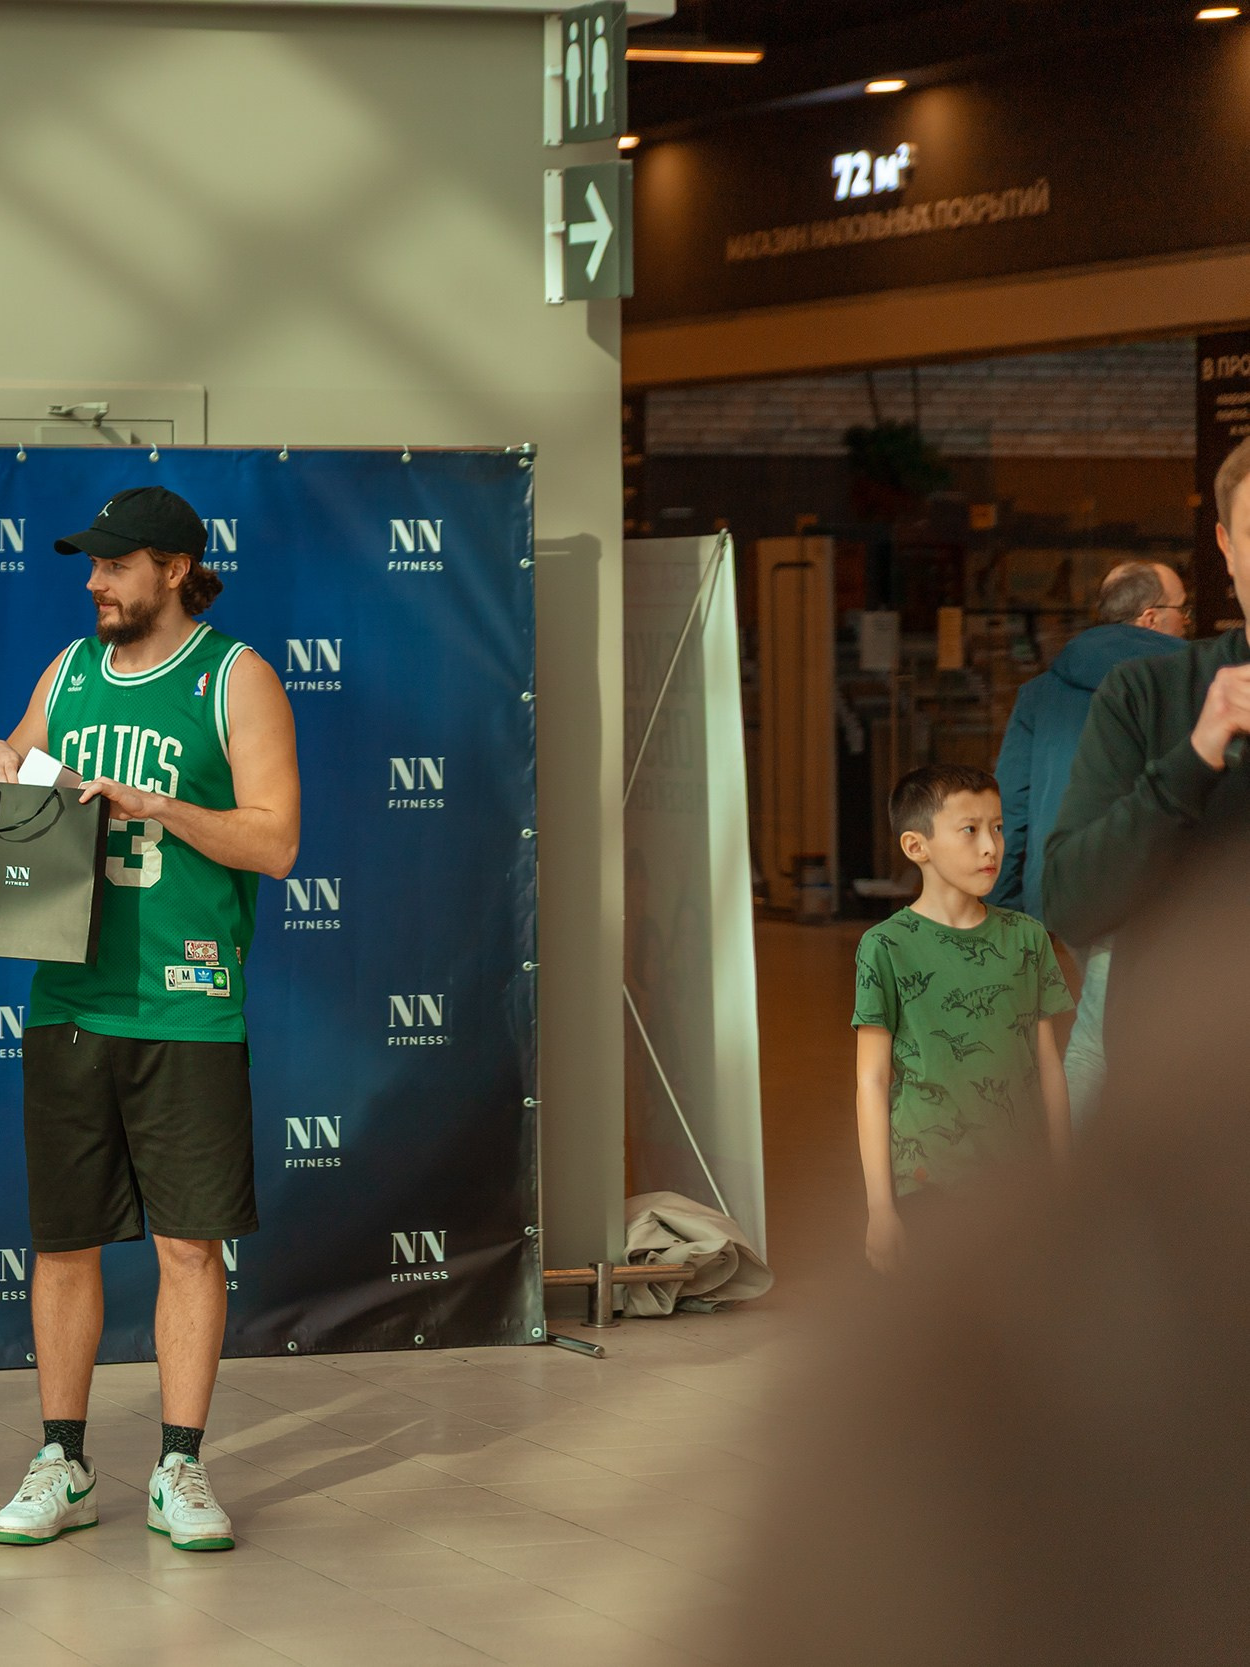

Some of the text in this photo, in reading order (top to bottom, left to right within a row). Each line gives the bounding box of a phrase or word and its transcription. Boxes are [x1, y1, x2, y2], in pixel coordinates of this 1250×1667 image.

[832, 150, 871, 201] 72
[726, 177, 1050, 262] МАГАЗИН НАПОЛЬНЫХ ПОКРЫТИЙ
[390, 520, 442, 552] NN
[388, 561, 443, 570] FITNESS
[287, 639, 341, 671] NN
[285, 681, 341, 691] FITNESS
[390, 757, 444, 790] NN
[389, 799, 444, 808] FITNESS
[5, 865, 30, 880] NN
[286, 878, 341, 911] NN
[285, 920, 340, 929] FITNESS
[182, 970, 190, 980] M
[389, 994, 444, 1027] NN
[389, 1036, 444, 1045] FITNESS
[285, 1116, 341, 1149] NN
[286, 1158, 340, 1168] FITNESS
[391, 1231, 446, 1264] NN
[392, 1271, 448, 1282] FITNESS
